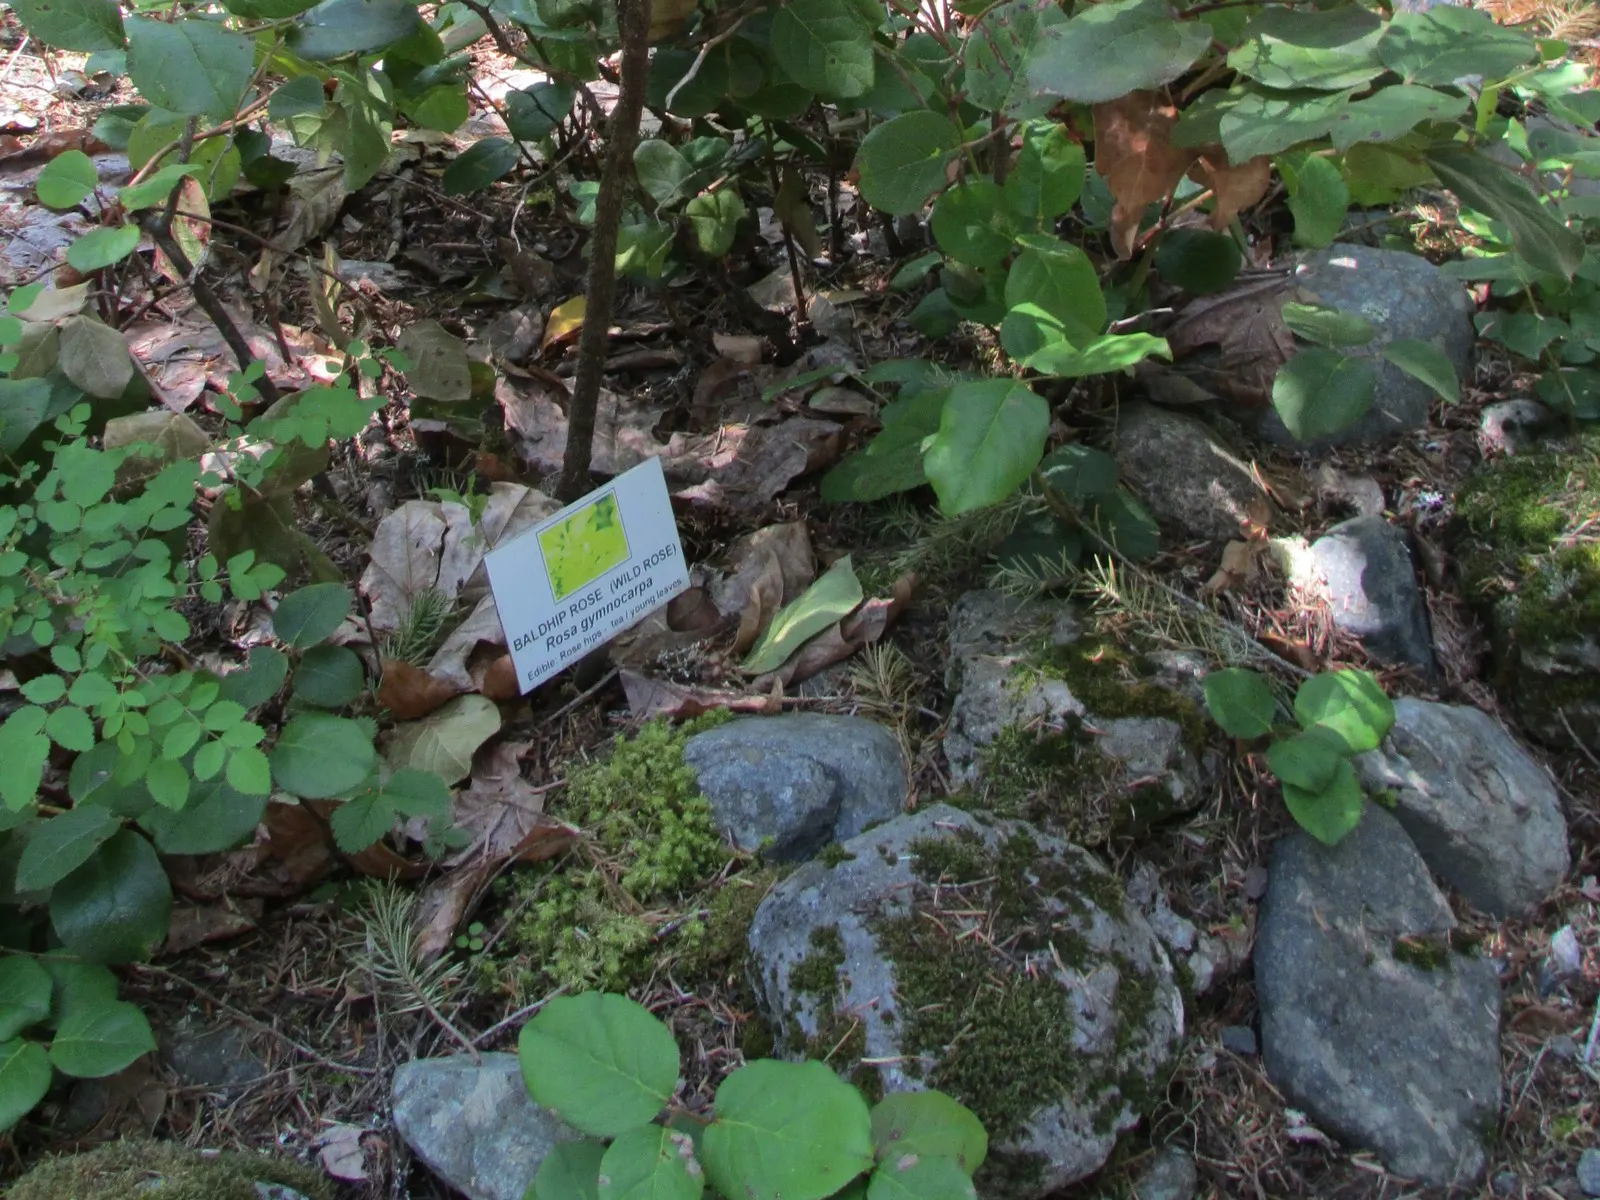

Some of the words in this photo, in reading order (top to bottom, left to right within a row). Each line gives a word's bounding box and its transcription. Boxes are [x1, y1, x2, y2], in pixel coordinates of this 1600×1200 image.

[513, 611, 566, 651] BALDHIP
[570, 588, 603, 618] ROSE
[610, 565, 641, 594] (WILD
[643, 543, 677, 571] ROSE)
[528, 657, 558, 681] Edible:
[560, 643, 582, 660] Rose
[584, 630, 602, 647] hips
[611, 616, 624, 627] tea
[630, 596, 656, 618] young
[656, 578, 682, 601] leaves
[546, 623, 577, 652] Rosa
[580, 576, 653, 632] gymnocarpa
